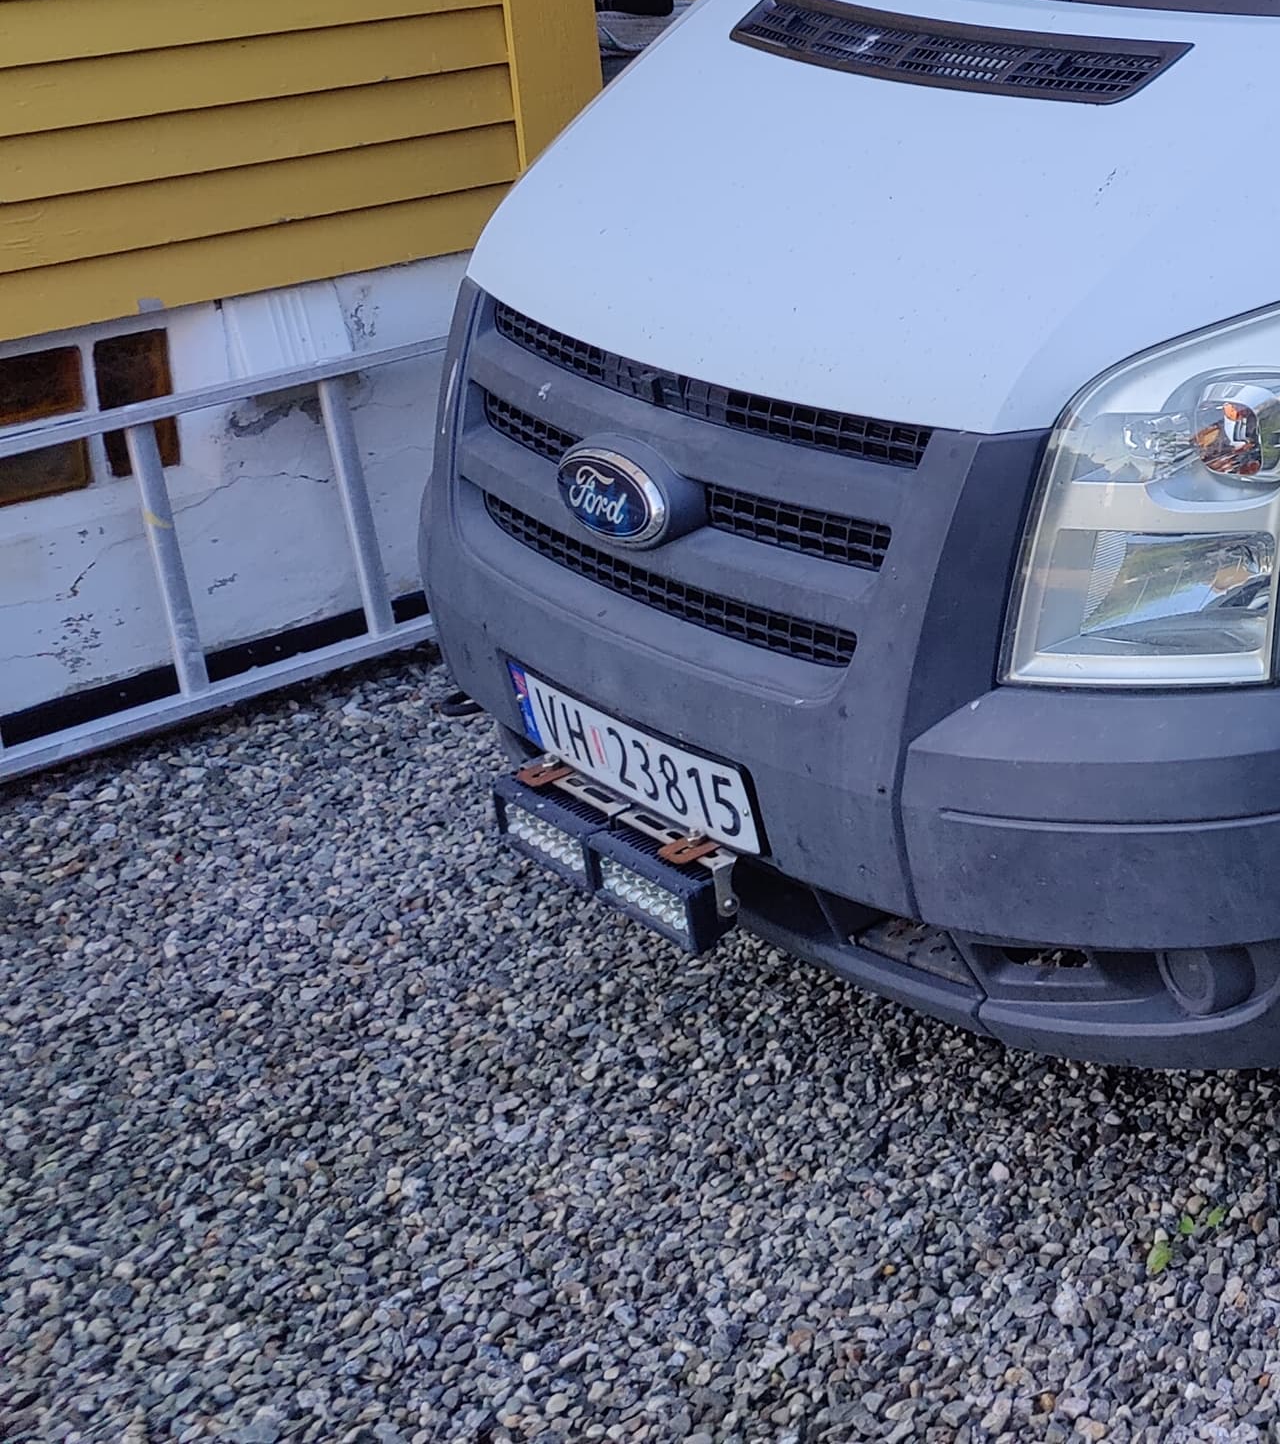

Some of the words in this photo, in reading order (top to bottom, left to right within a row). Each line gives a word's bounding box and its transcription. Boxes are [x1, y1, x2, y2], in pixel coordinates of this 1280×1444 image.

[569, 465, 627, 525] Ford
[535, 687, 595, 768] VH
[607, 726, 741, 837] 23815
